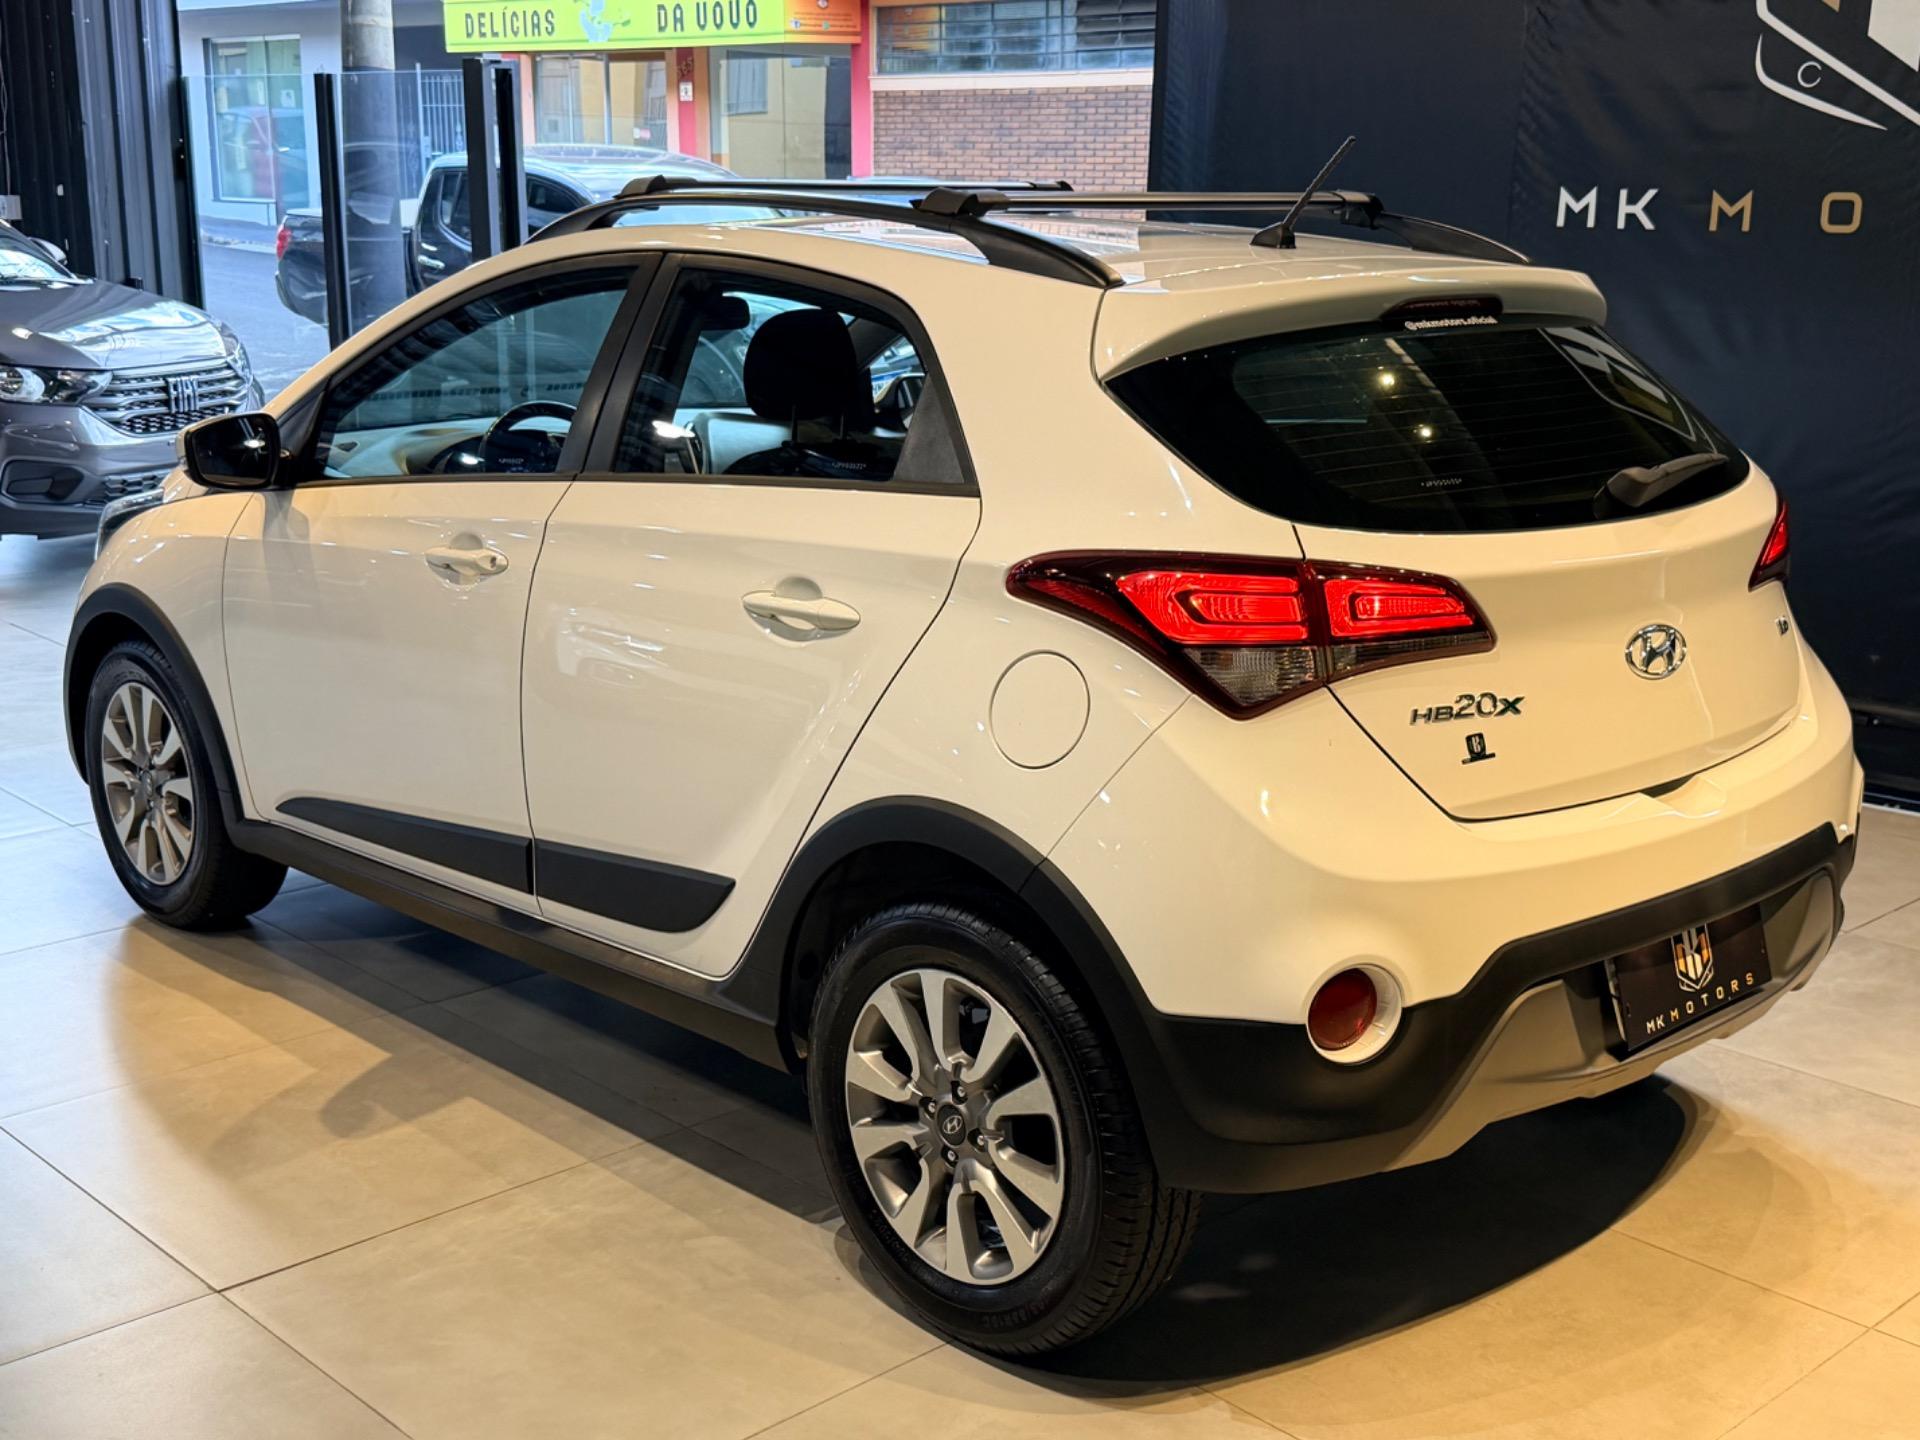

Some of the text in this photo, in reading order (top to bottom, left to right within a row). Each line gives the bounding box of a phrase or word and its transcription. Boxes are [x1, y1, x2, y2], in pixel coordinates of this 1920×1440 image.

[464, 6, 555, 39] DELÍCIAS
[656, 3, 684, 33] DA
[1556, 185, 1660, 231] MK
[166, 374, 201, 414] FIAT
[1645, 972, 1755, 1035] MK MOTORS
